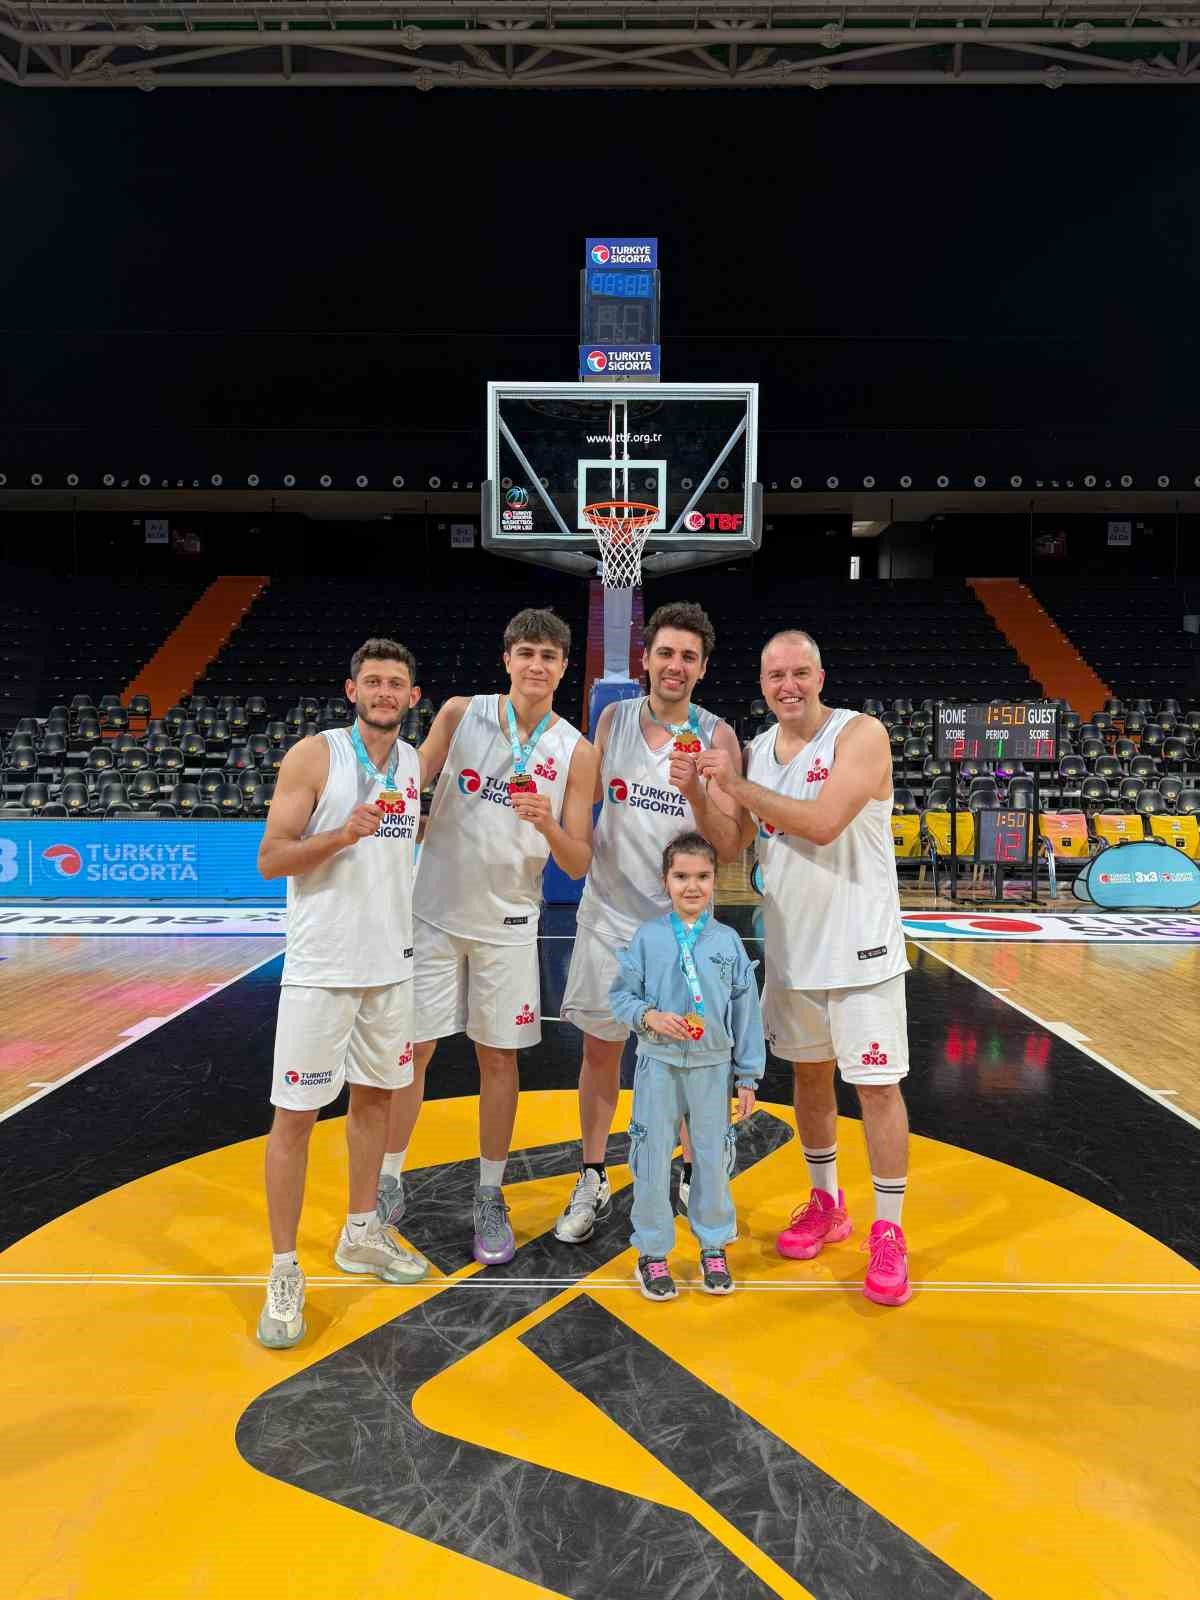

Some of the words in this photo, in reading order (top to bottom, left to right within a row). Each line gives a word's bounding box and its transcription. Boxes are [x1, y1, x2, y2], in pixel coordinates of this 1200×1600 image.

[705, 513, 743, 530] TBF
[938, 709, 967, 724] HOME
[986, 706, 1026, 725] 1:50
[1028, 709, 1056, 724] GUEST
[945, 729, 966, 740] SCORE
[985, 729, 1009, 740] PERIOD
[1029, 729, 1049, 740] SCORE
[534, 764, 558, 781] 3x3
[806, 768, 829, 782] 3x3
[996, 813, 1025, 828] 1:50
[994, 832, 1023, 863] 12
[1135, 871, 1158, 883] 3x3
[862, 1053, 887, 1066] 3x3
